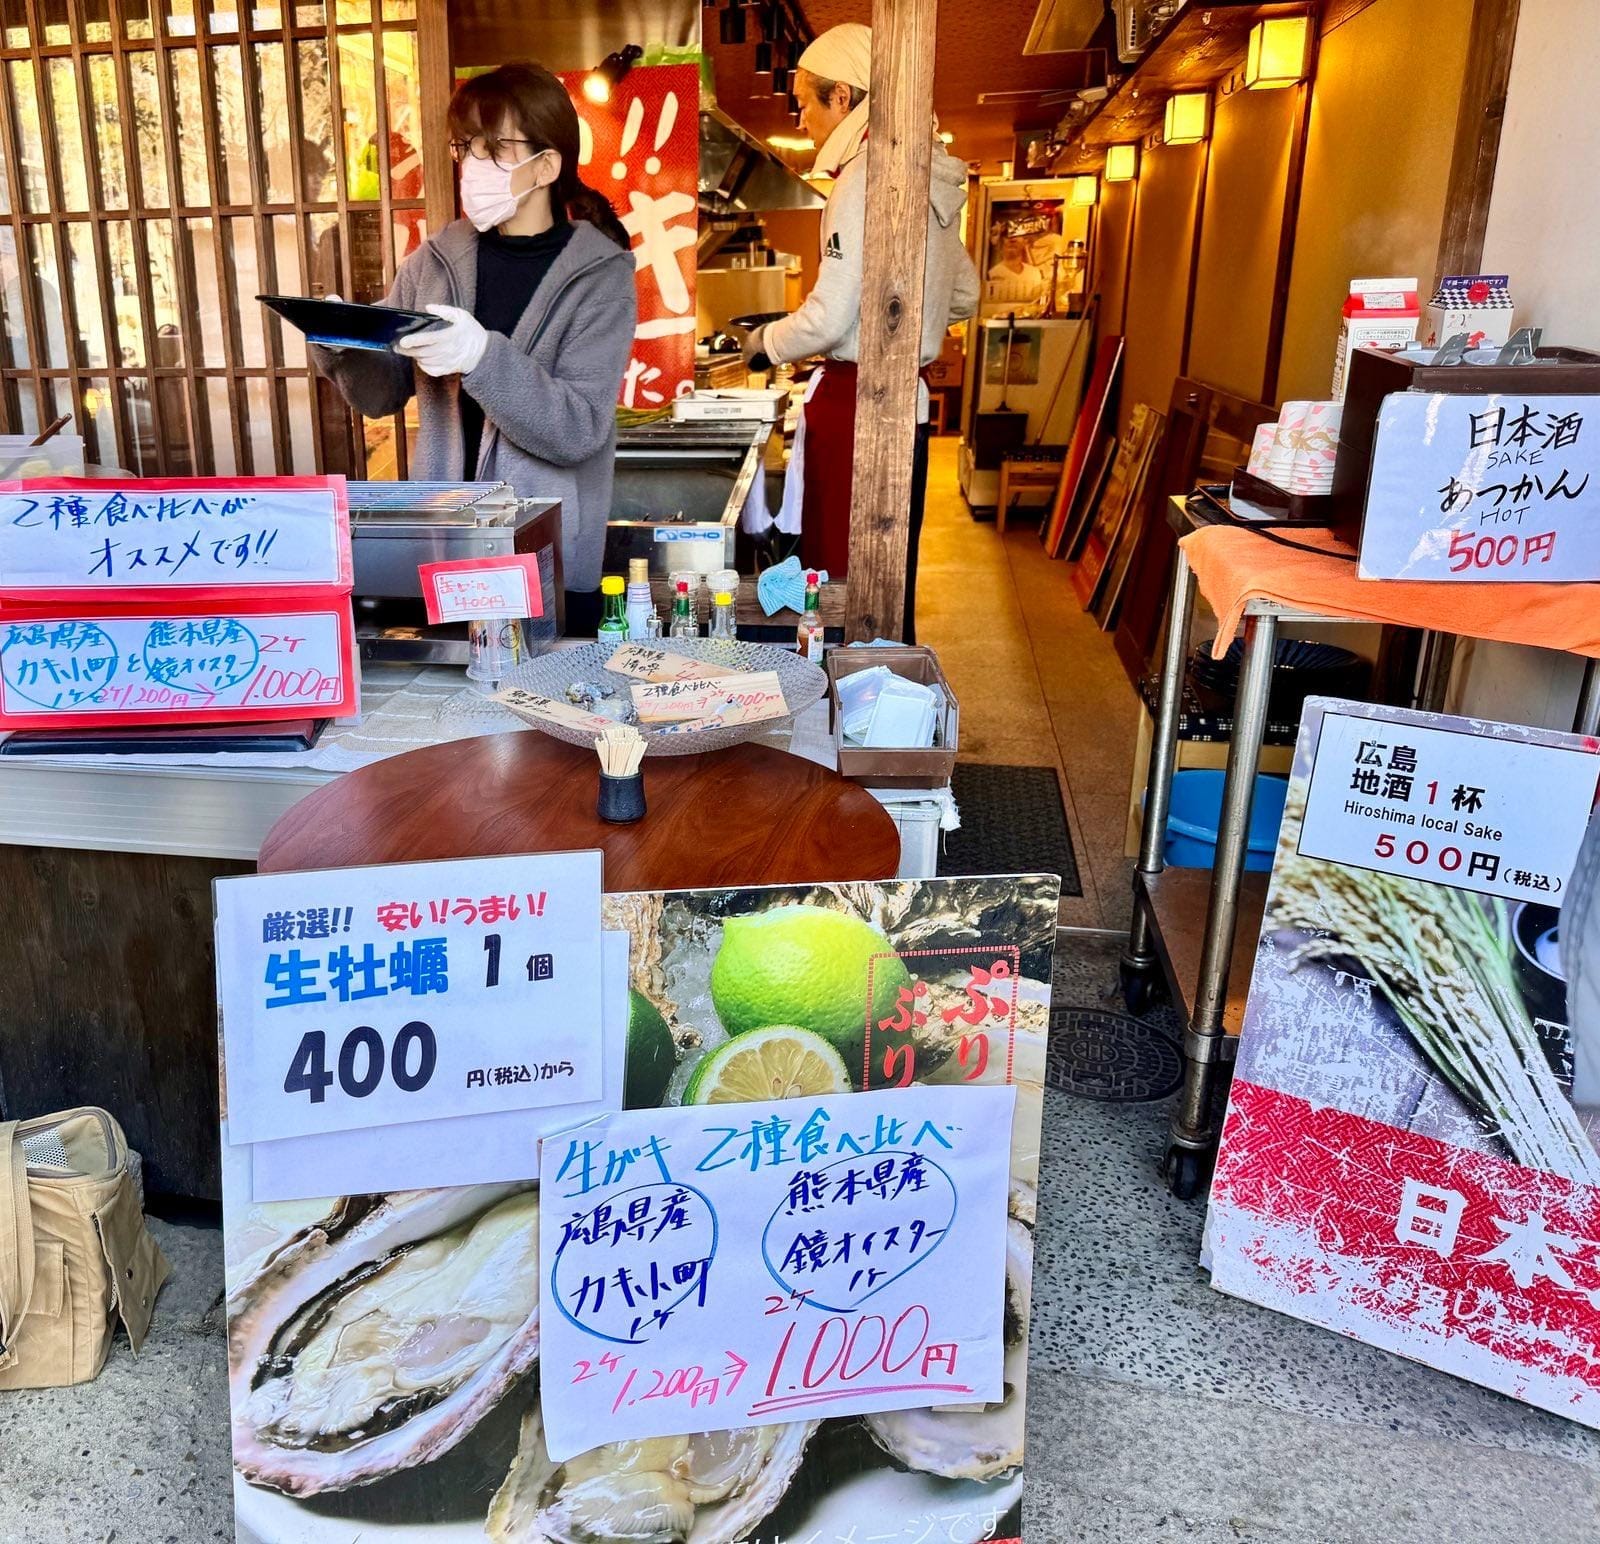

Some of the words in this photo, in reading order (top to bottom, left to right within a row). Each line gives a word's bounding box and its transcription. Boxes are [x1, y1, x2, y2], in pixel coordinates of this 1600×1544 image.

[1469, 403, 1584, 450] 日本酒
[1486, 450, 1545, 470] SAKE
[1437, 469, 1590, 513] あつかん
[1480, 506, 1531, 526] HOT
[88, 529, 279, 577] オススメです!!
[1448, 530, 1557, 572] 500円
[3, 623, 105, 652] 広島県産
[148, 620, 247, 649] 熊本県産
[1355, 739, 1418, 774] 広島
[1343, 800, 1416, 827] Hiroshima
[1420, 813, 1458, 834] local
[1463, 822, 1503, 842] Sake
[263, 906, 354, 943] 厳選!!
[377, 891, 547, 932] 安い!うまい!
[264, 937, 448, 1009] 生牡蠣
[483, 933, 503, 988] 1
[526, 953, 554, 982] 個
[878, 981, 928, 1088] ぷり
[941, 960, 1010, 1081] ぷり
[283, 1020, 437, 1104] 400
[785, 1152, 930, 1215] 熊本県産
[556, 1187, 693, 1254] 広島県産
[1395, 1176, 1600, 1295] 日本
[779, 1220, 946, 1275] 鏡オイスター
[569, 1256, 714, 1318] カキ小町
[729, 1506, 1009, 1544] メージです
